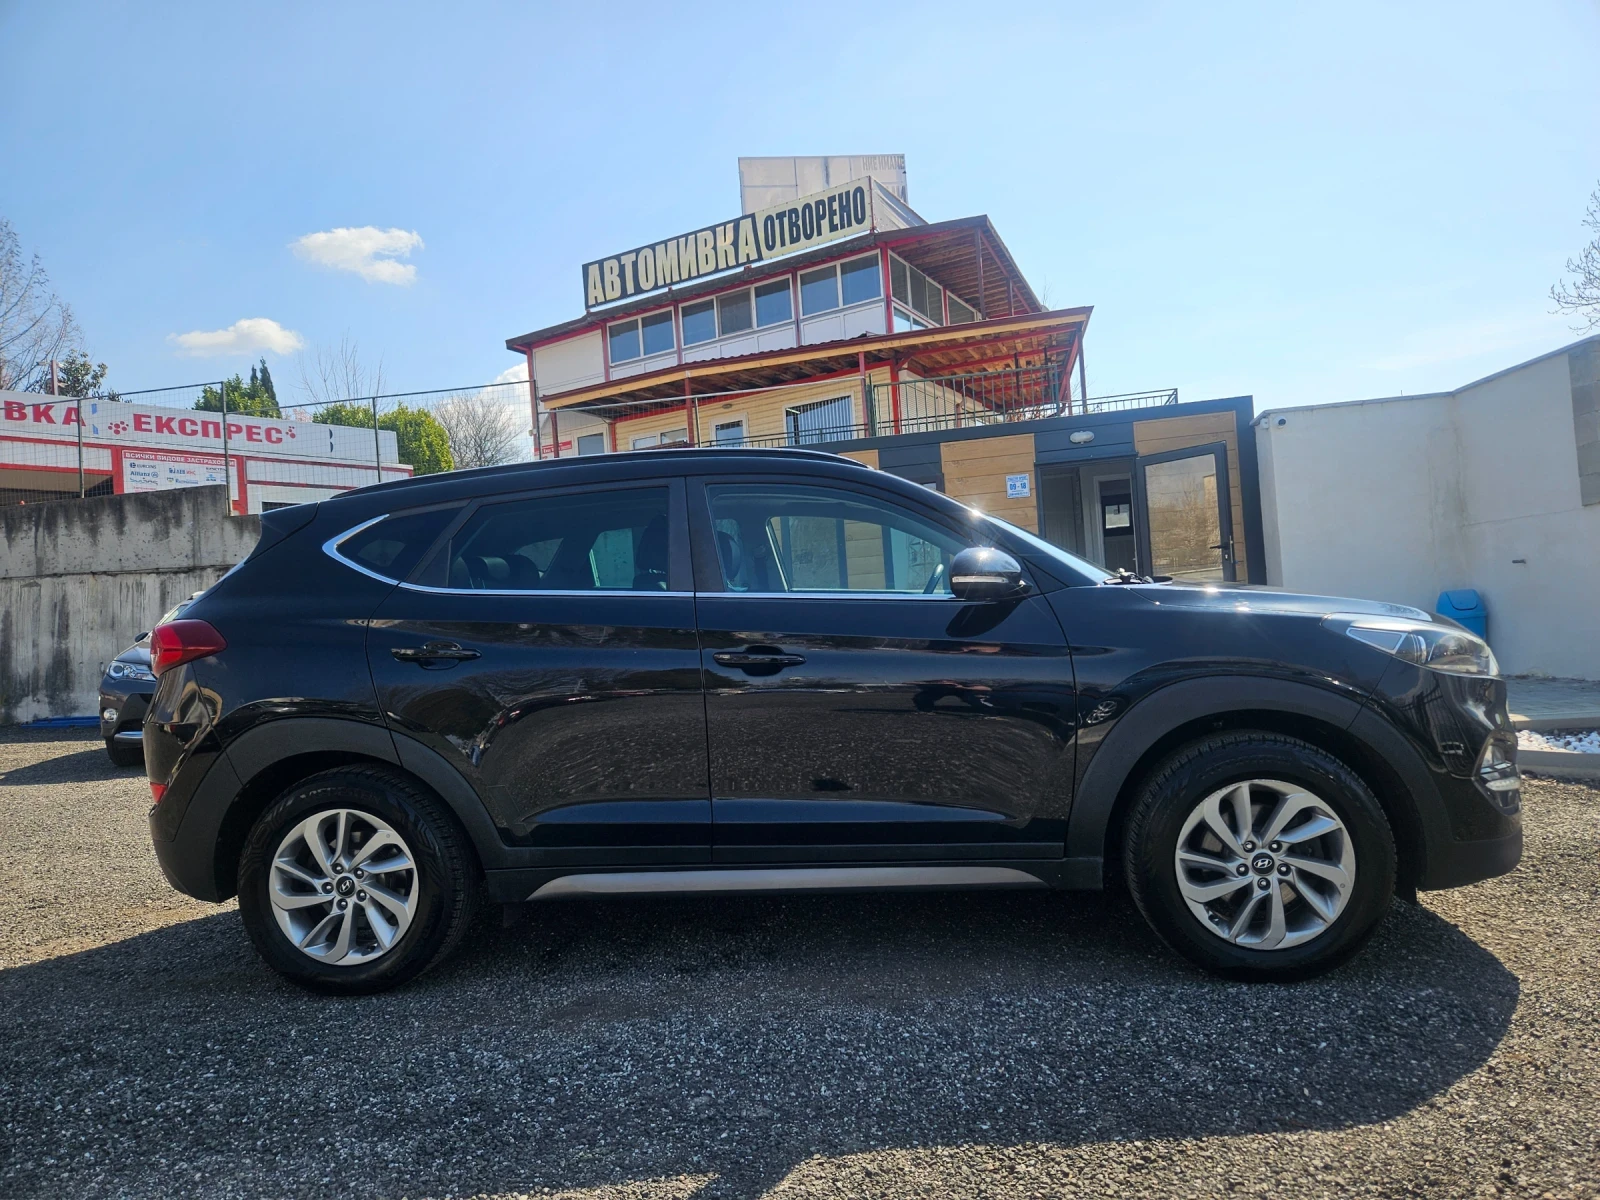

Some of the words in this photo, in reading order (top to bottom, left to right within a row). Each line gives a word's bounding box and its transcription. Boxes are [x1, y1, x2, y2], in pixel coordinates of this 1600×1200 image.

[587, 216, 759, 306] АВТОМИВКА
[763, 185, 865, 251] ОТВОРЕНО
[4, 400, 86, 427] ВКА
[133, 413, 283, 444] ЕКСПРЕС
[156, 455, 185, 463] ВИДОВЕ
[187, 458, 235, 466] ЗАСТРАХОВИ
